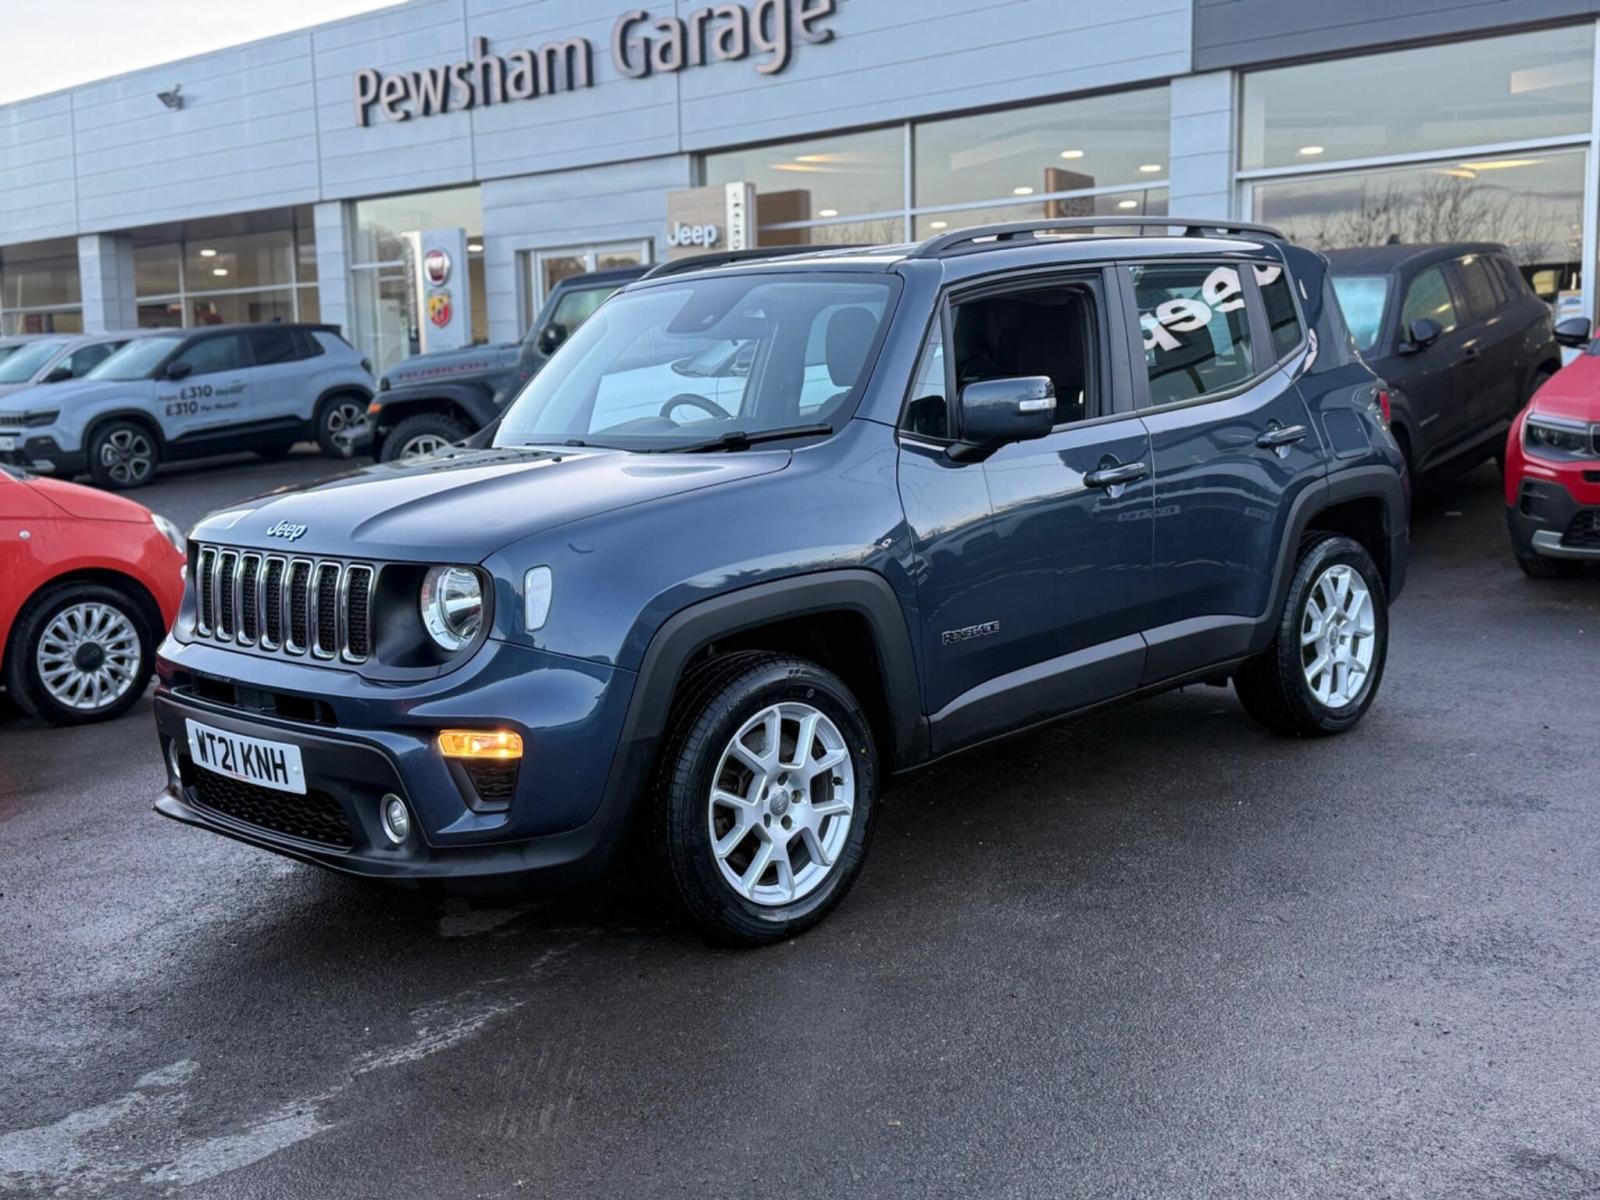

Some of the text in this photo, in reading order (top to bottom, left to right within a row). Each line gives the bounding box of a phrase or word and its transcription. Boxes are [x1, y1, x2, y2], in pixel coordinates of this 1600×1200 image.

[353, 0, 836, 128] Pewsham Garage
[667, 221, 720, 249] Jeep
[180, 384, 213, 401] £310
[166, 401, 198, 417] £310
[266, 519, 308, 543] Jeep
[195, 727, 289, 785] WT21 KNH
